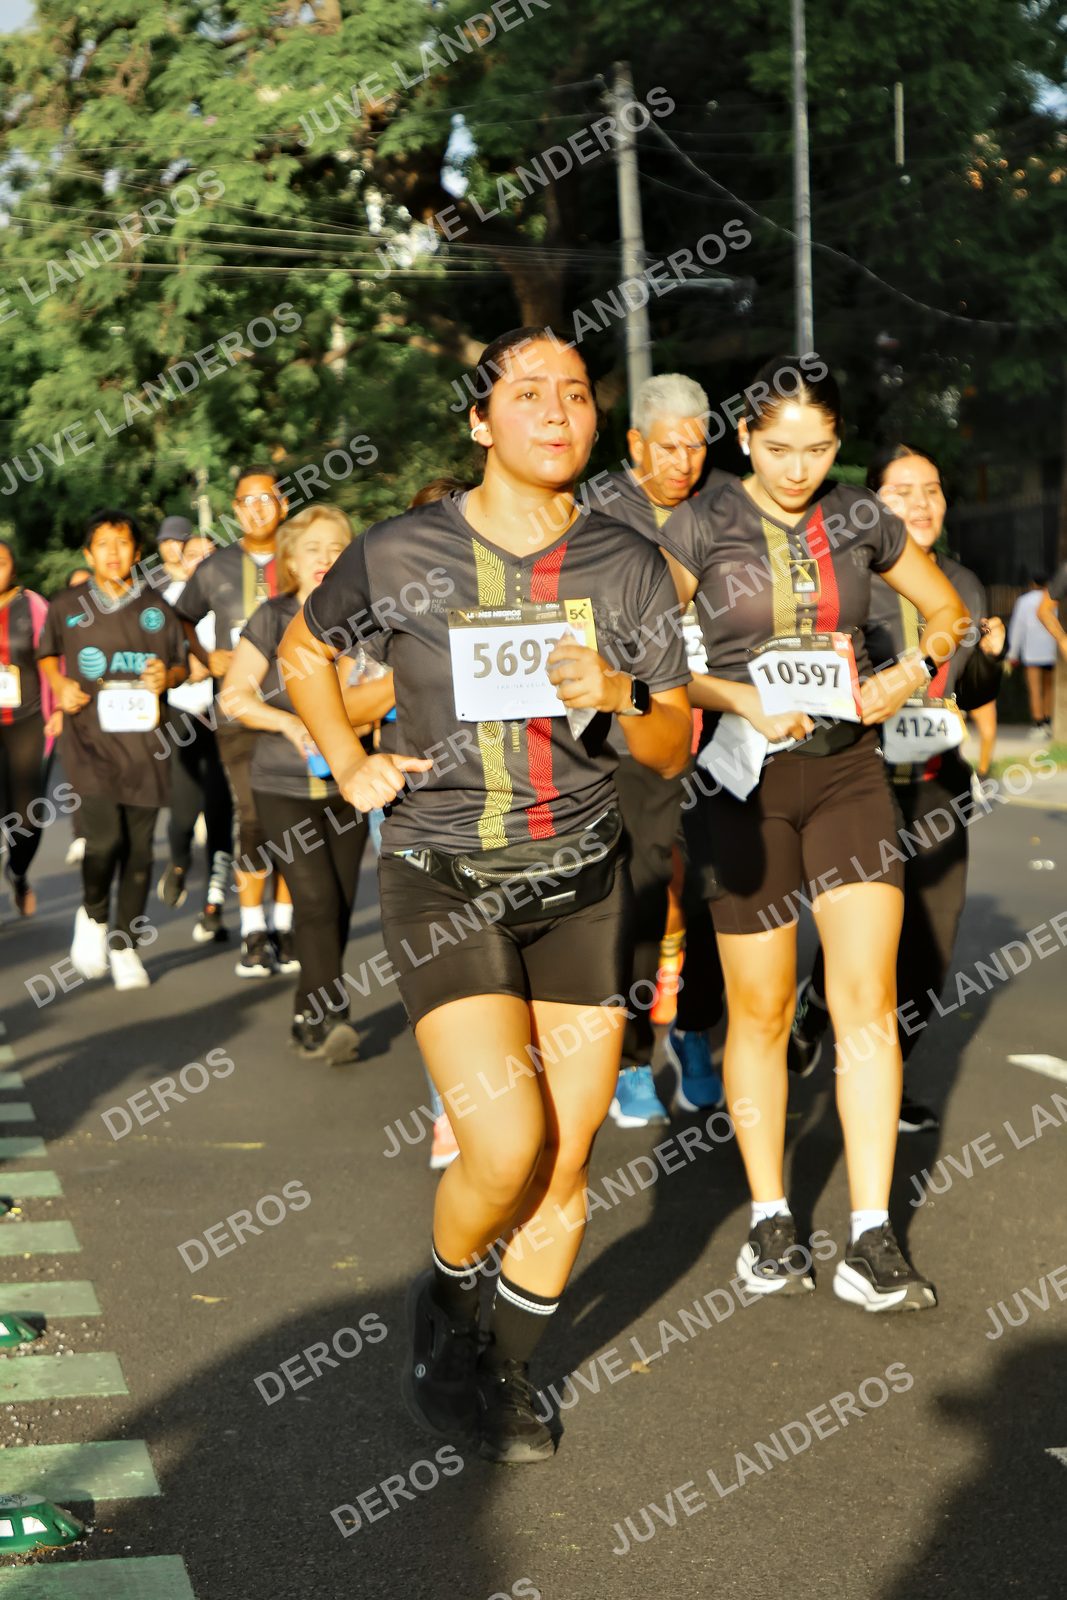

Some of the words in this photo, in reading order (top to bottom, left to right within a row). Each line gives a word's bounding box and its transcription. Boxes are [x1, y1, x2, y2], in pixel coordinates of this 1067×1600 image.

[569, 608, 587, 621] 5K
[757, 659, 841, 688] 10597
[895, 716, 948, 737] 4124
